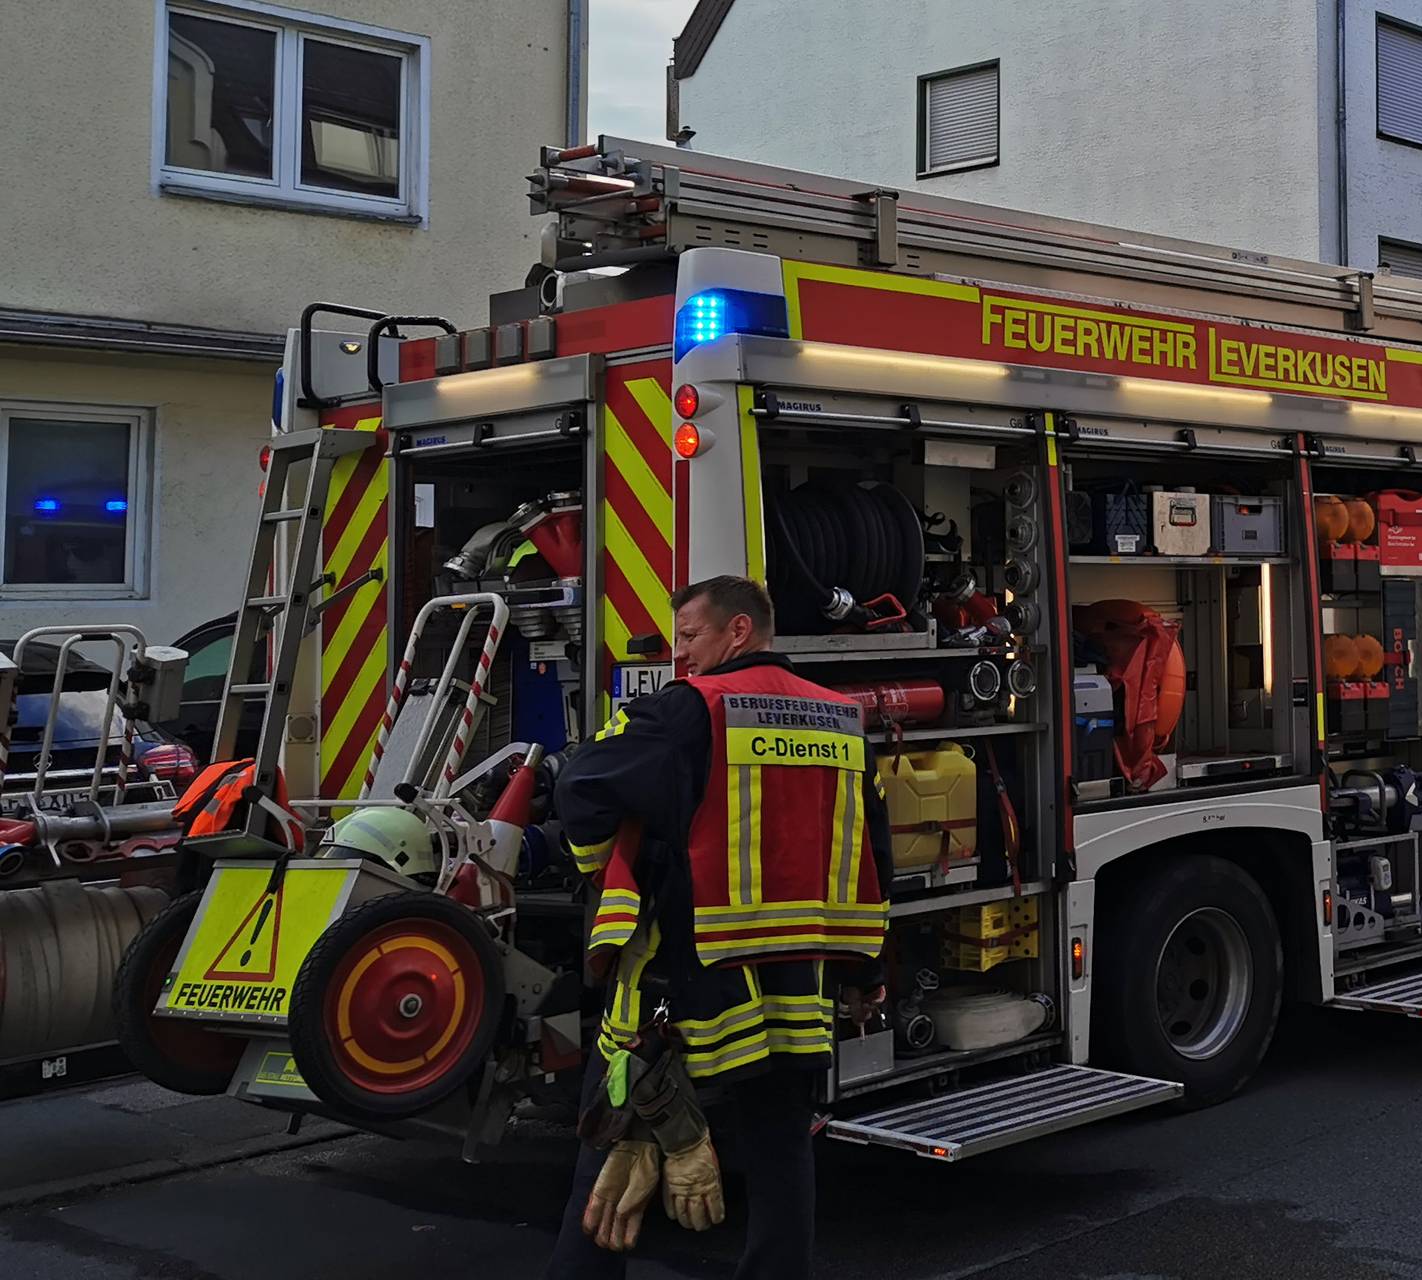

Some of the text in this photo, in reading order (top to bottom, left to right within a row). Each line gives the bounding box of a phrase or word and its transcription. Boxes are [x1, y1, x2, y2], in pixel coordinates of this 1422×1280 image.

[982, 295, 1389, 400] FEUERWEHR LEVERKUSEN
[1393, 628, 1405, 690] BOCH
[626, 670, 662, 698] LEV
[729, 697, 859, 719] BERUFSFEUERWEHR
[758, 711, 841, 729] LEVERKUSEN
[752, 737, 850, 761] C-Dienst 1
[174, 982, 287, 1011] FEUERWEHR
